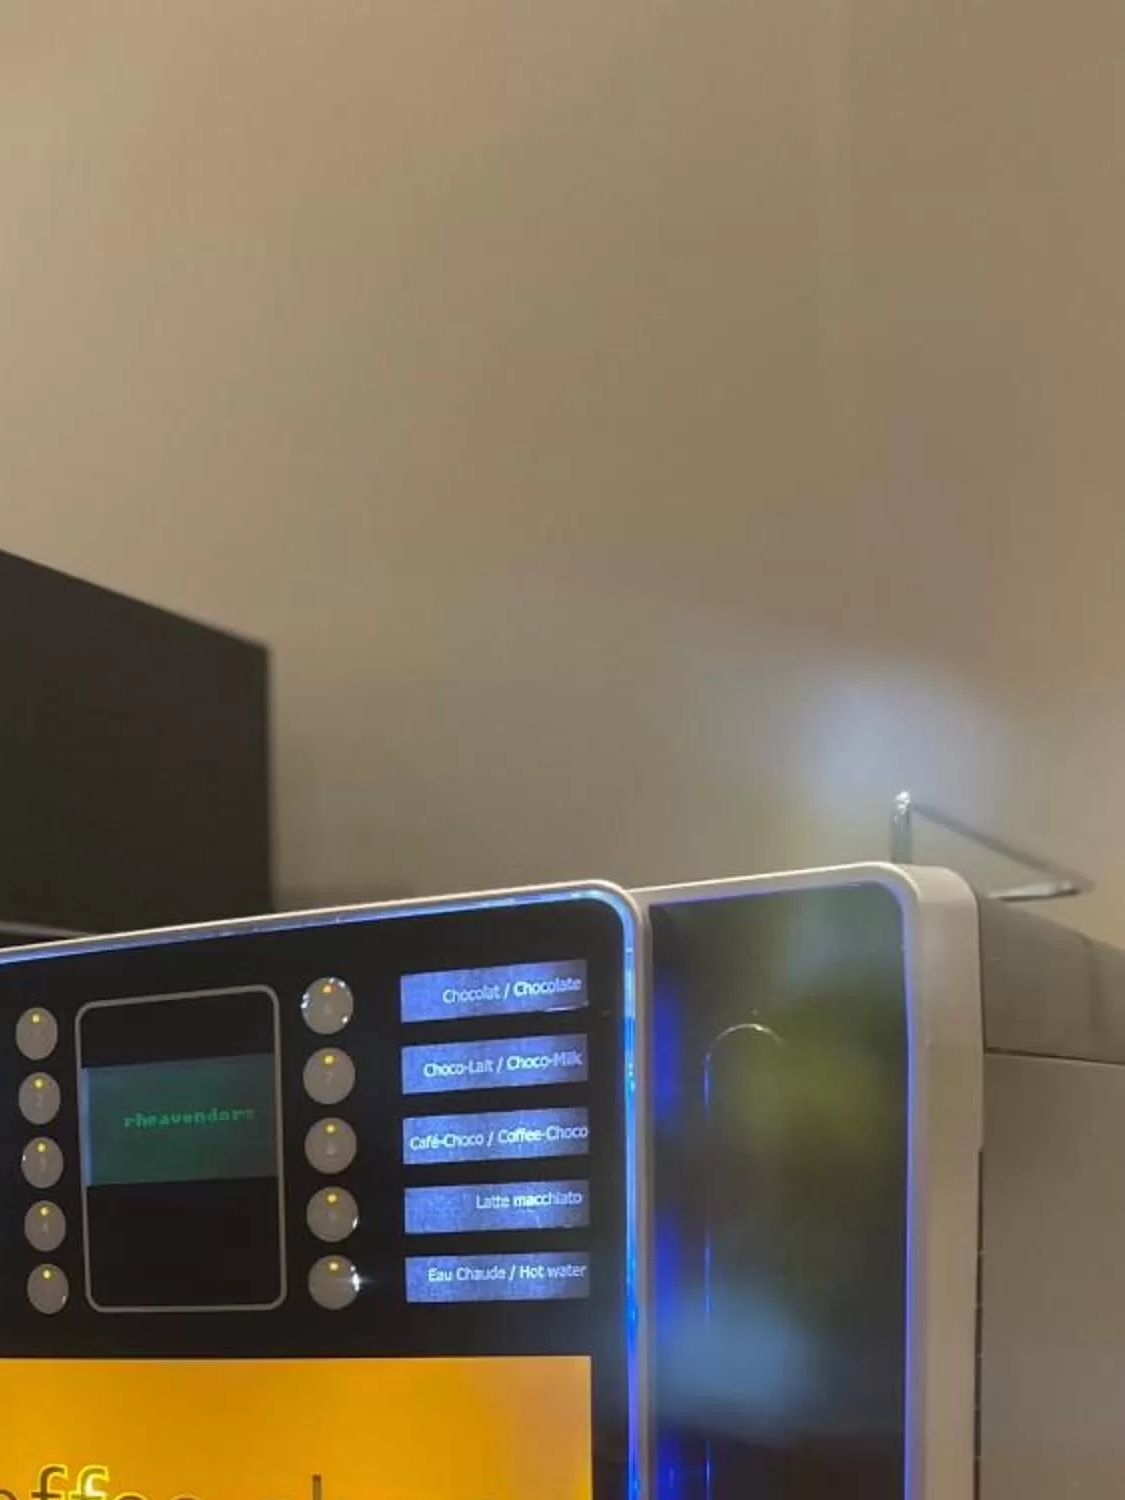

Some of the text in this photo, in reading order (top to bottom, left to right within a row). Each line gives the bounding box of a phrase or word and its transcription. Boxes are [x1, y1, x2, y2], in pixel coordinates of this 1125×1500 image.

[443, 985, 500, 1004] Chocolat
[513, 977, 583, 996] Chocolate
[506, 1050, 583, 1071] Choco-Milk
[123, 1107, 256, 1128] rheavendors
[498, 1125, 589, 1144] Coffee-Choco
[475, 1190, 583, 1209] Latte macchiato
[427, 1268, 452, 1282] Eau
[456, 1266, 506, 1281] Chaude
[519, 1264, 545, 1279] Hot
[547, 1263, 587, 1278] water
